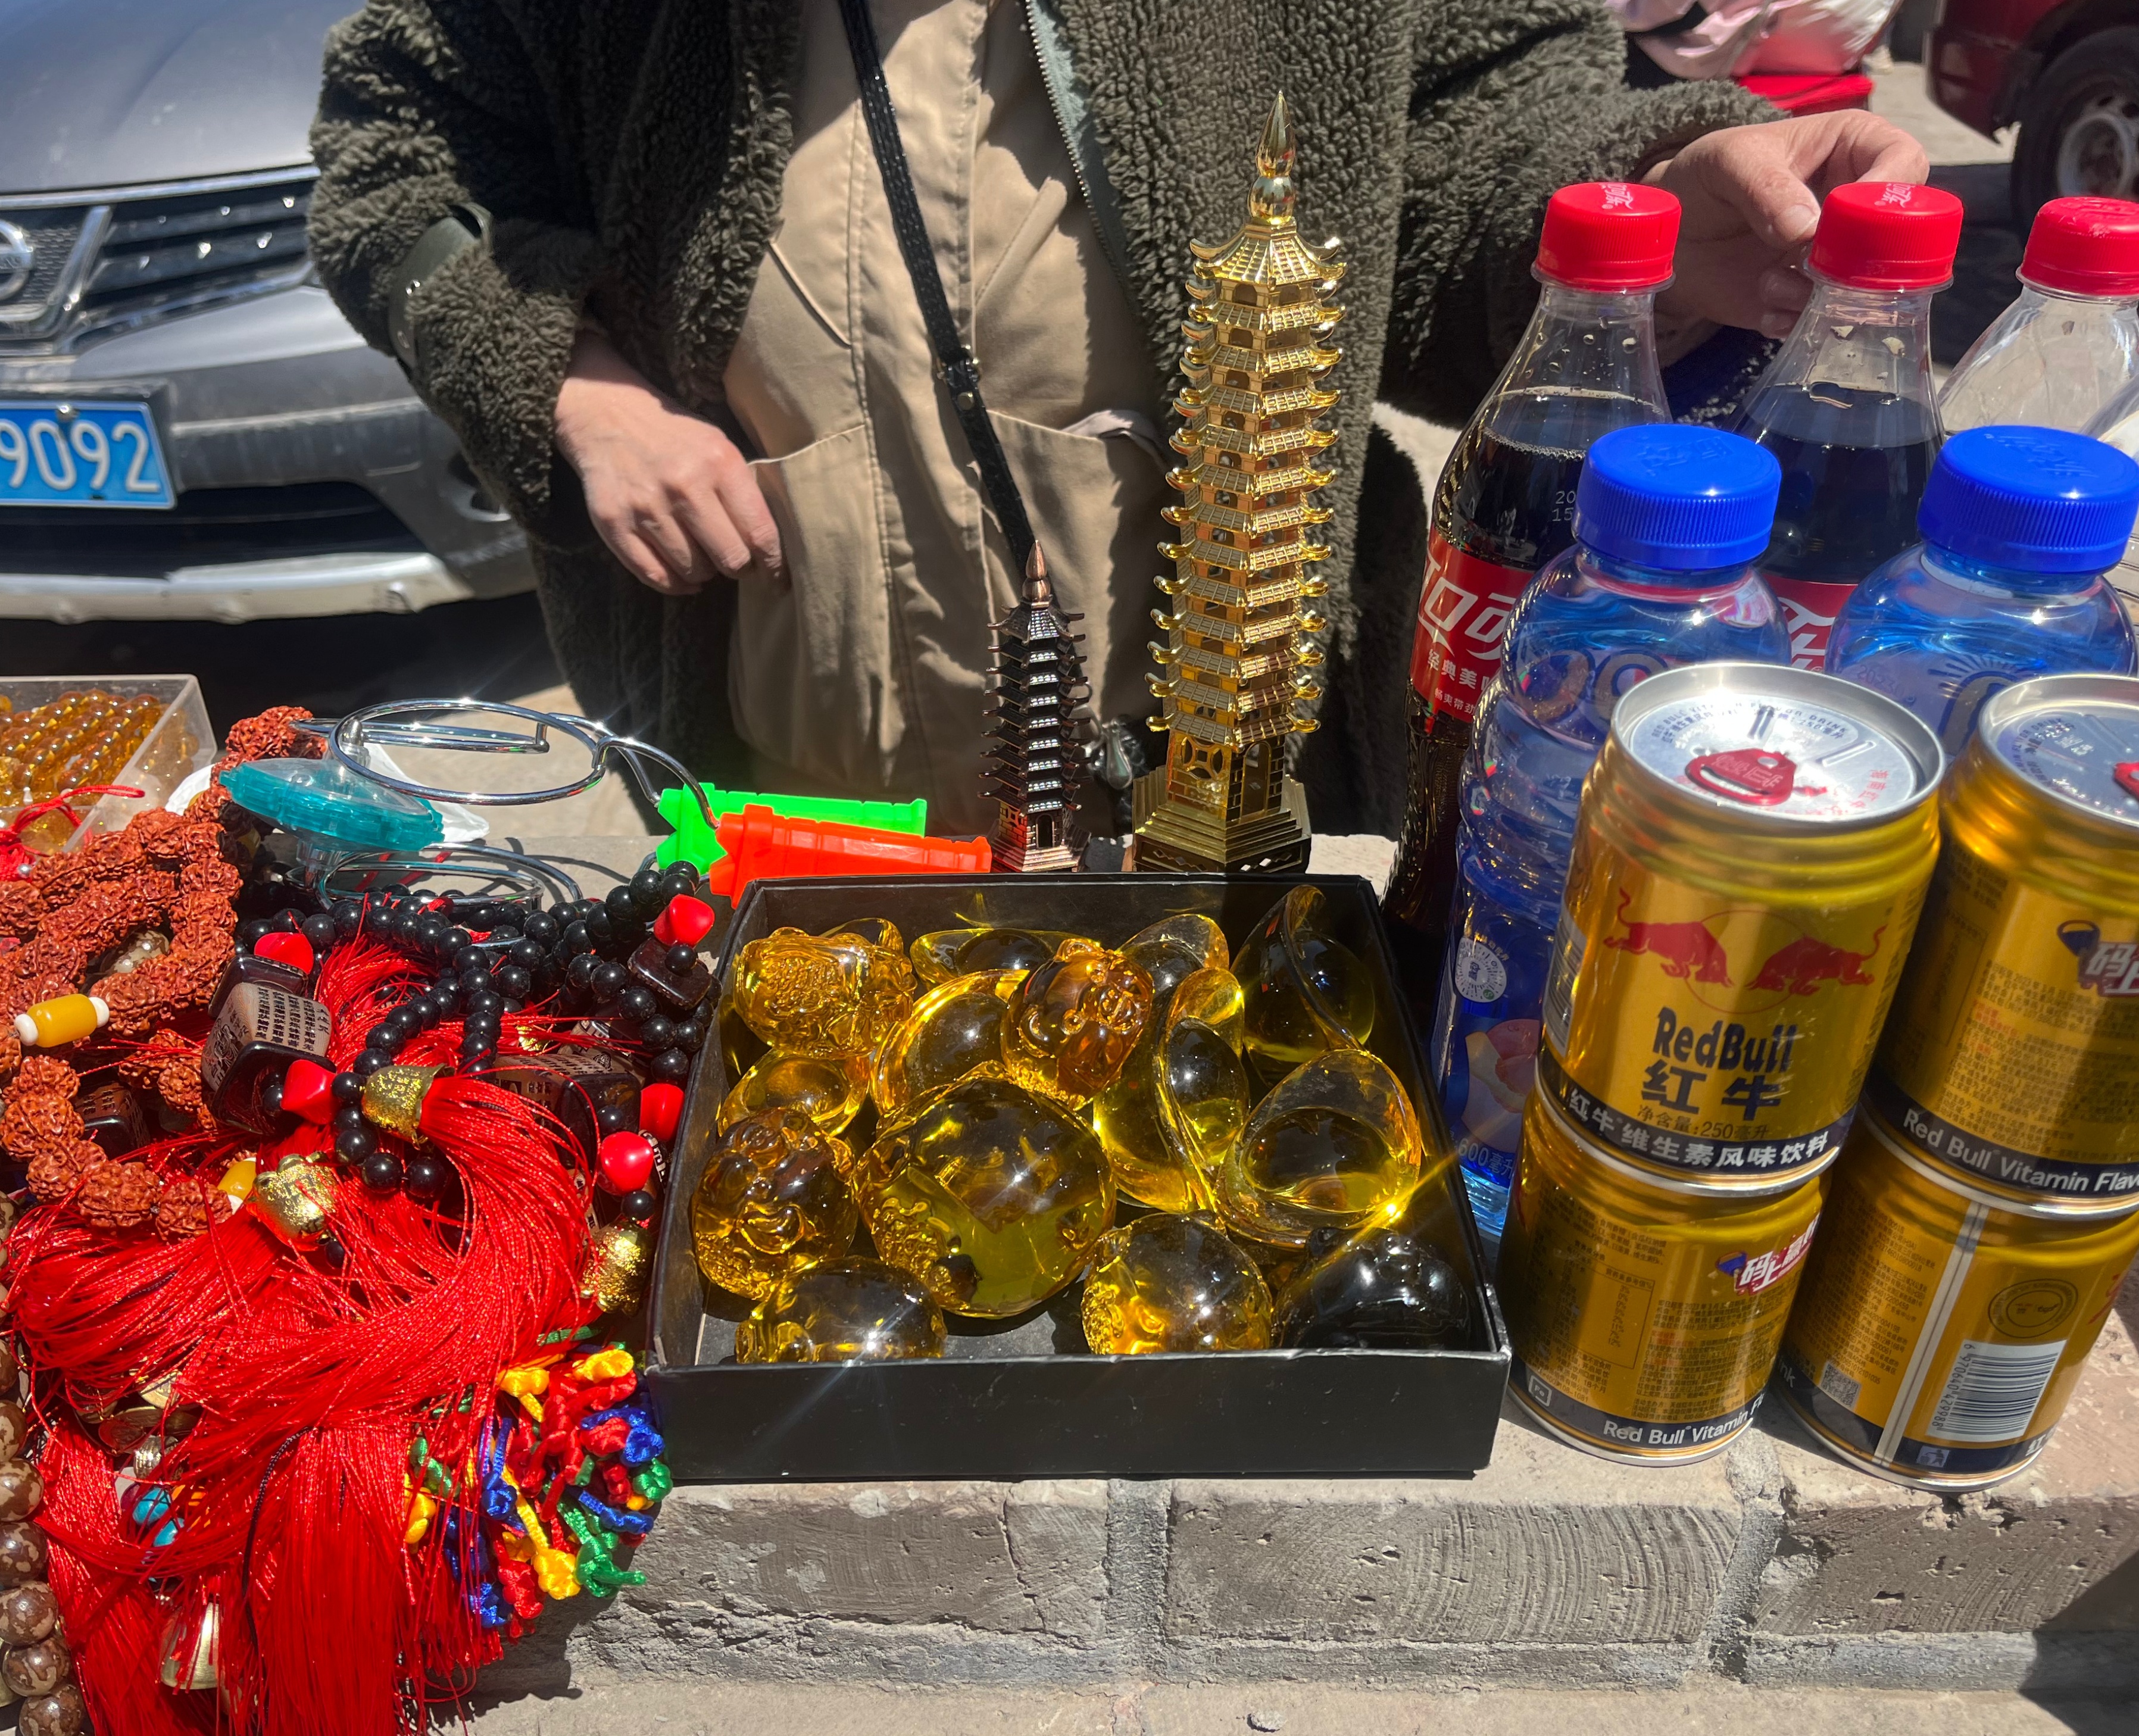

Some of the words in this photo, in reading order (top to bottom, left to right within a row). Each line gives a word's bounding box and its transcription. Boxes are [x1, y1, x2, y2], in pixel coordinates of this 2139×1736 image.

[0, 419, 161, 493] 9092
[1641, 1059, 1782, 1121] 红牛
[1904, 1109, 1944, 1148] Red
[1947, 1136, 1991, 1170] Bull
[2001, 1156, 2090, 1191] Vitamin
[1603, 1420, 1643, 1442] Red
[1648, 1429, 1685, 1445] Bull
[1692, 1410, 1748, 1442] Vitamin
